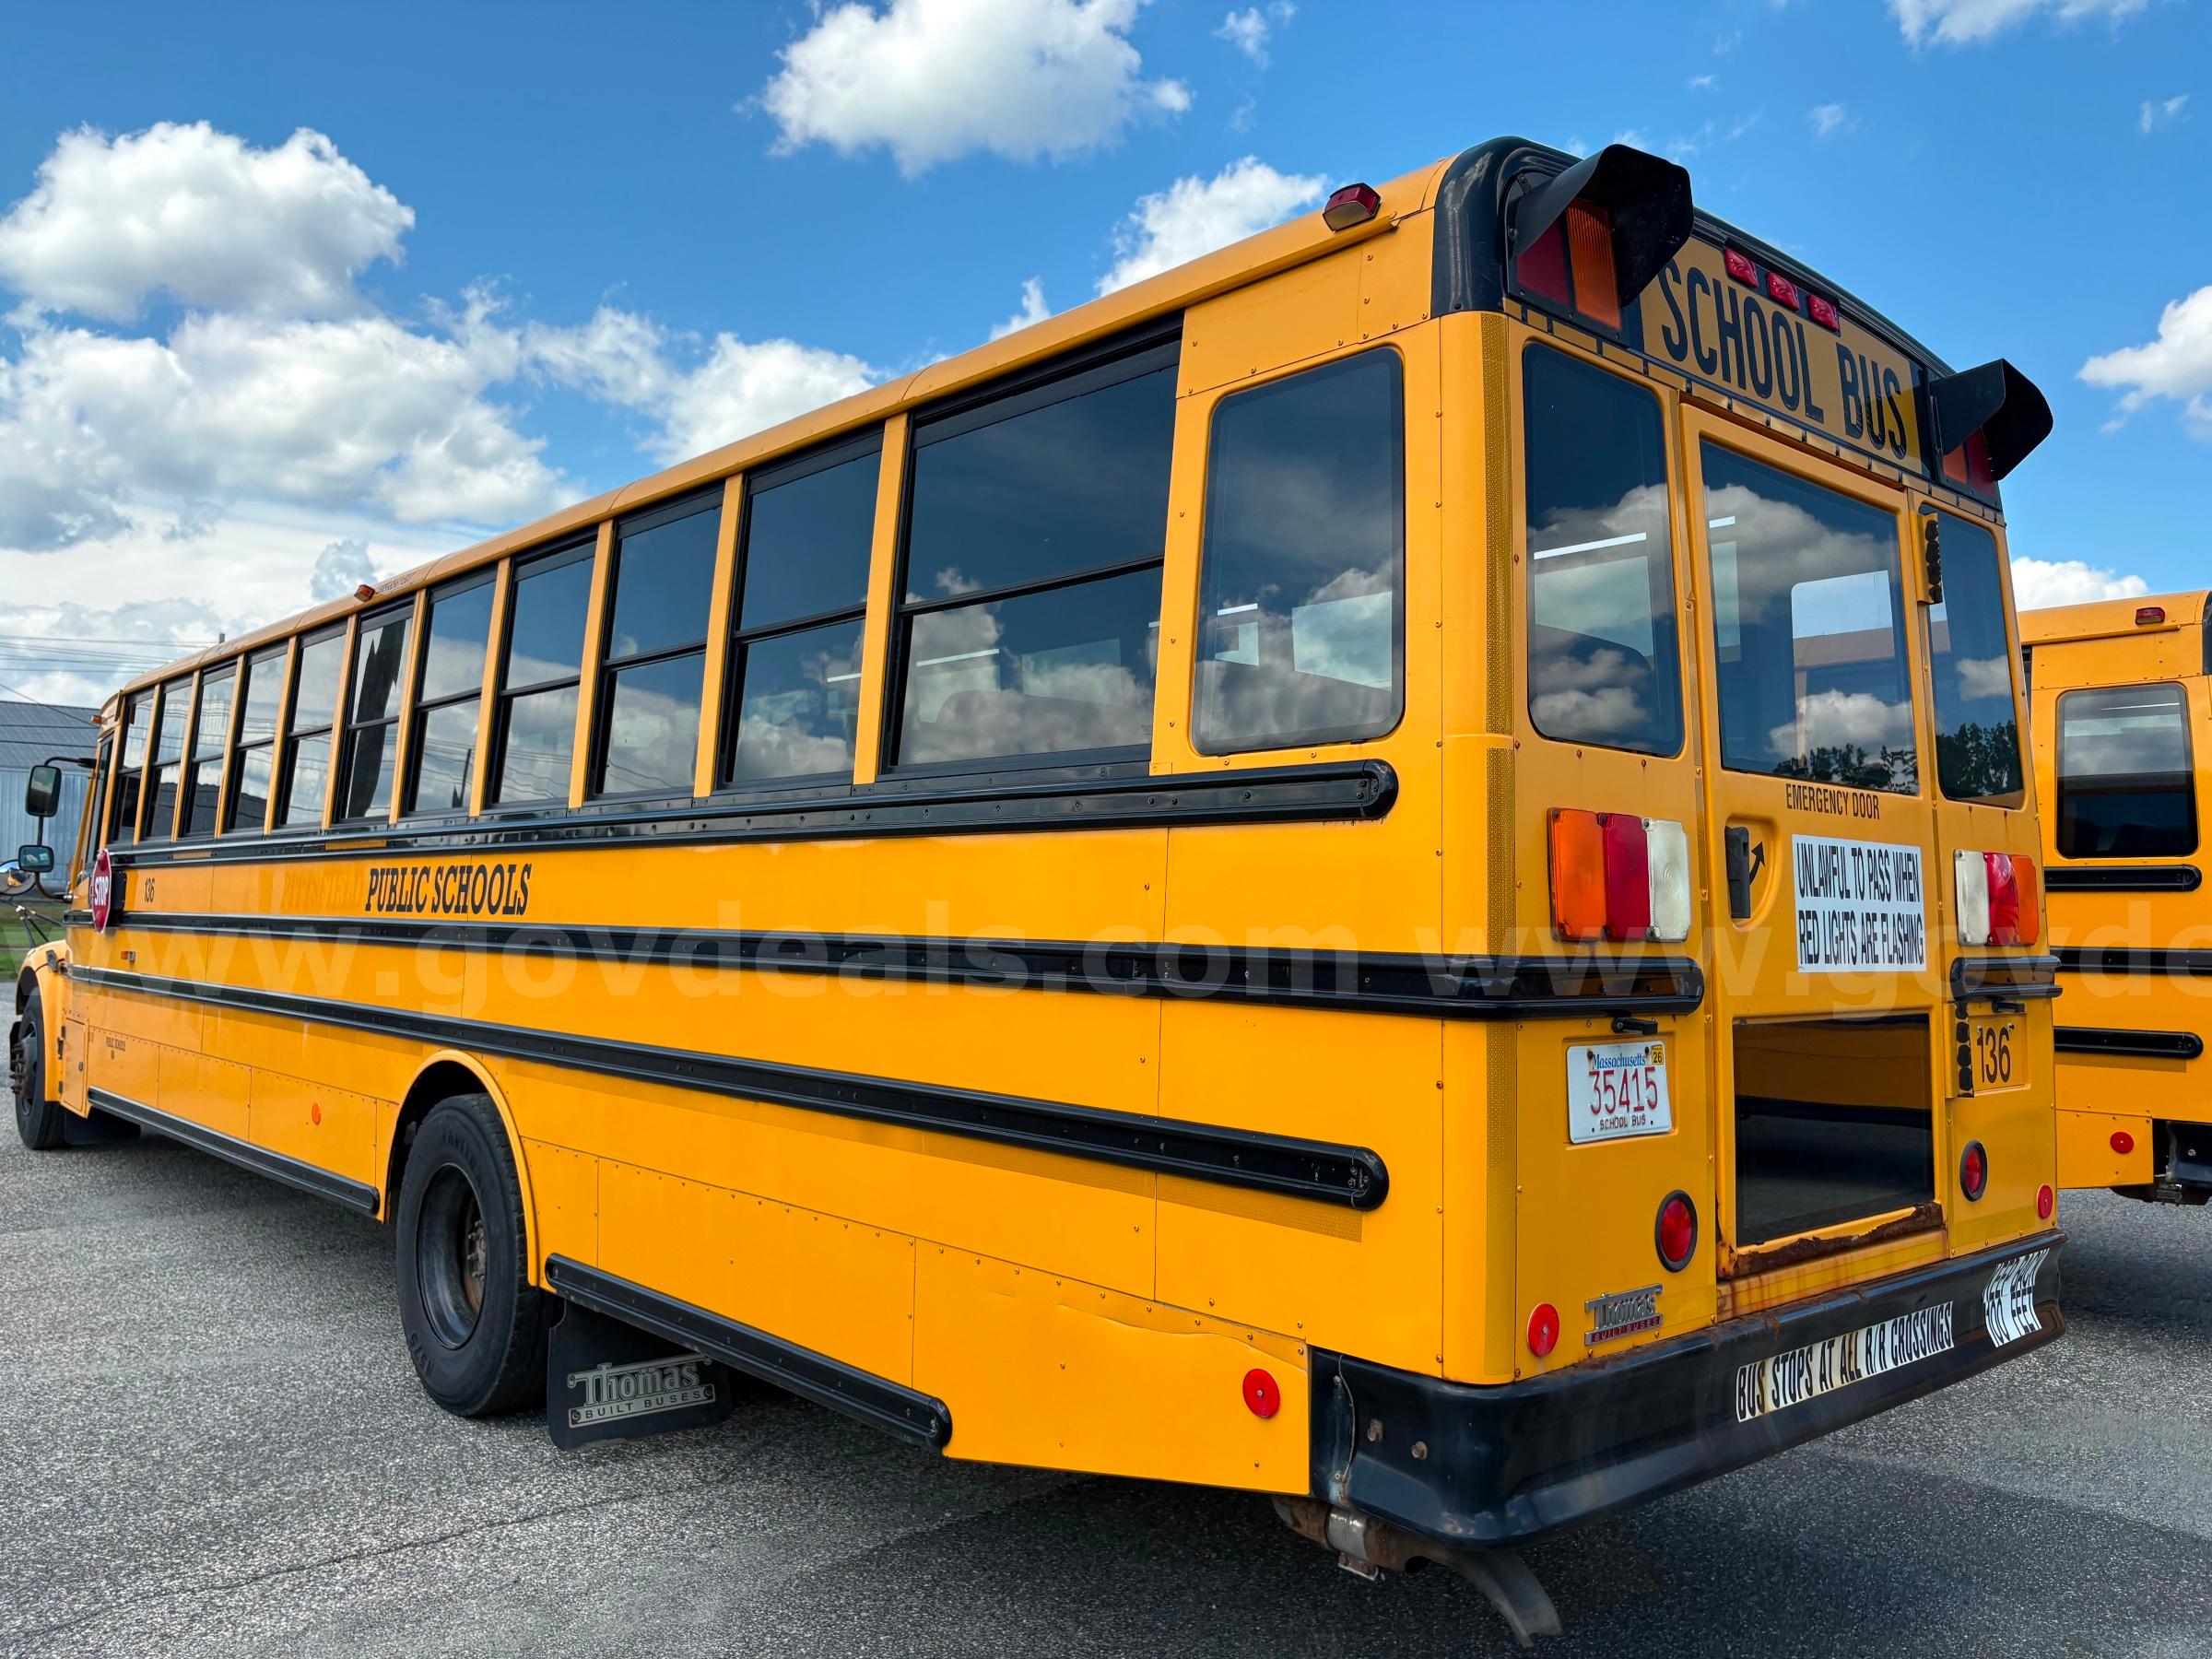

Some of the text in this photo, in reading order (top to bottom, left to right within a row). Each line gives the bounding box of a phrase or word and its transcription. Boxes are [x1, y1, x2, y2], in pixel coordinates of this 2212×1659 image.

[1658, 257, 1907, 460] SCHOOL BUS
[1786, 783, 1880, 819] EMERGENCY DOOR
[94, 876, 110, 906] STOP
[144, 877, 155, 903] 136
[365, 866, 431, 913] PUBLIC
[431, 864, 532, 915] SCHOOLS
[1796, 842, 1921, 902] UNLAWFUL TO PASS WHEN
[1798, 909, 1924, 966] RED LIGHTS ARE FLASHING
[1592, 1052, 1646, 1069] Massachusetts
[1653, 1051, 1664, 1064] 26
[1976, 1026, 2011, 1084] 136
[1588, 1065, 1658, 1115] 35415
[1599, 1113, 1646, 1131] SCHOOL BUS
[1585, 1283, 1663, 1332] Thomas
[1594, 1317, 1658, 1341] BUILT BUSES
[1985, 1287, 2041, 1347] 100 FEET
[568, 1354, 706, 1406] Thomas
[1737, 1301, 1953, 1420] BUS STOPS AT ALL R/R CROSSINGS
[585, 1391, 701, 1418] BUILT BUSES
